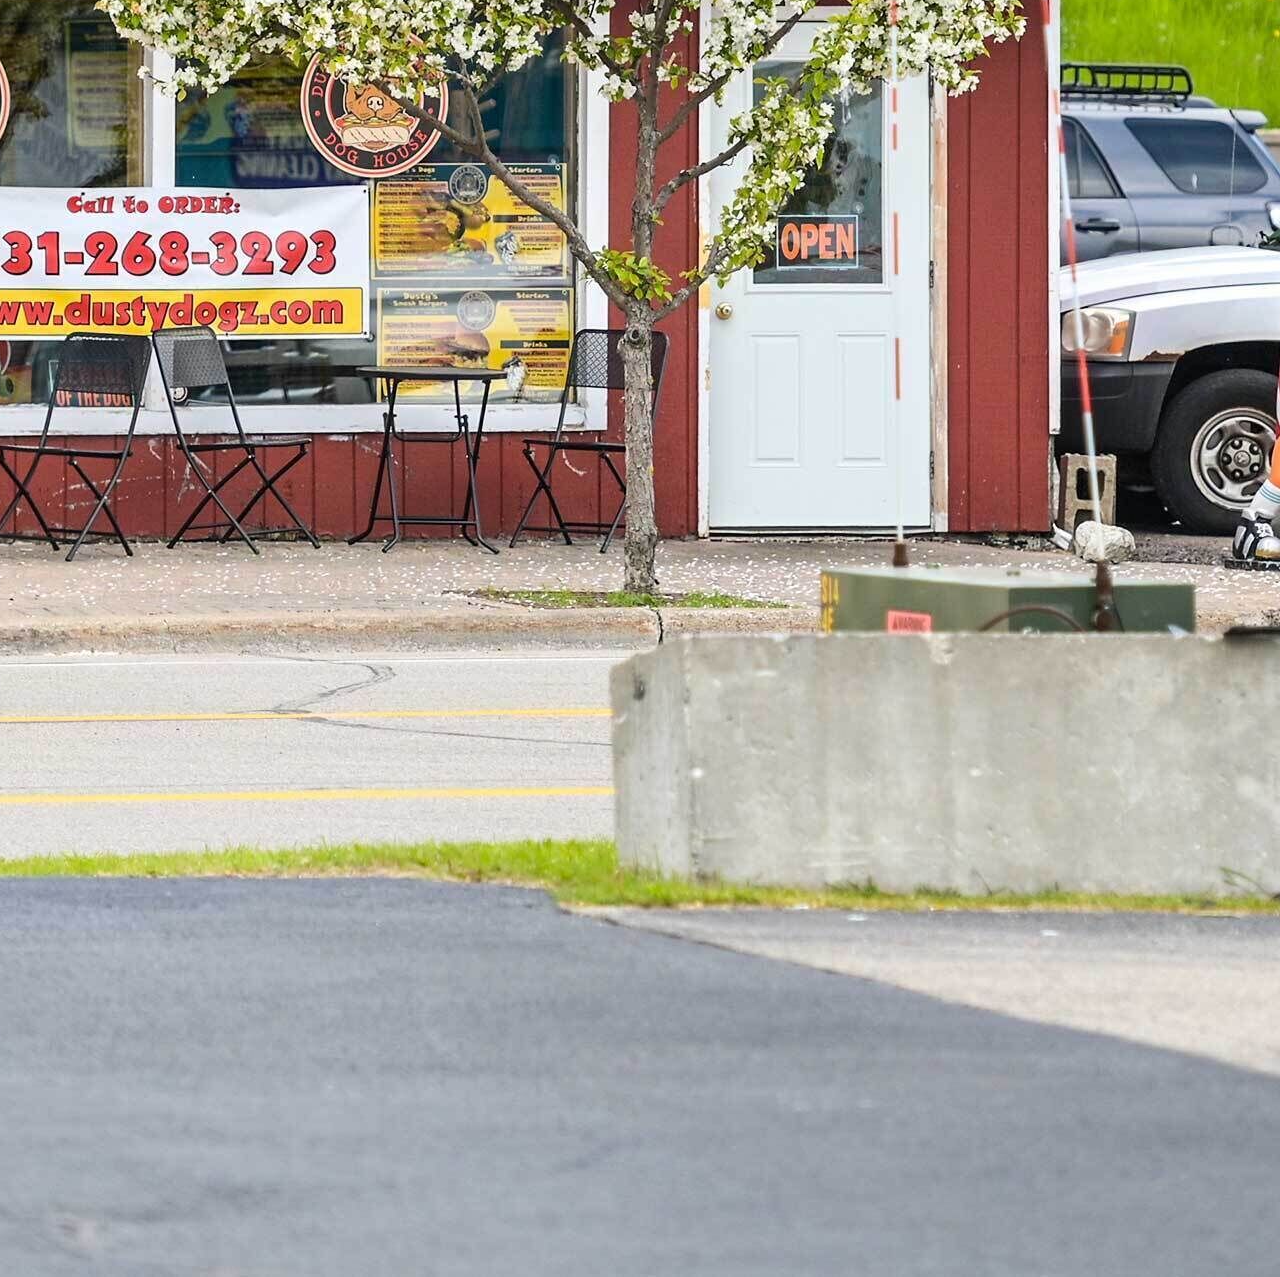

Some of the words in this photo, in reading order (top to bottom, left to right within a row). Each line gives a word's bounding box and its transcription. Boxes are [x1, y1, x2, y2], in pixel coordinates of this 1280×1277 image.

[323, 133, 360, 165] DOG
[372, 129, 428, 168] HOUSE
[66, 195, 116, 214] Call
[122, 195, 150, 214] to
[158, 195, 241, 215] ORDER:
[780, 222, 855, 260] OPEN
